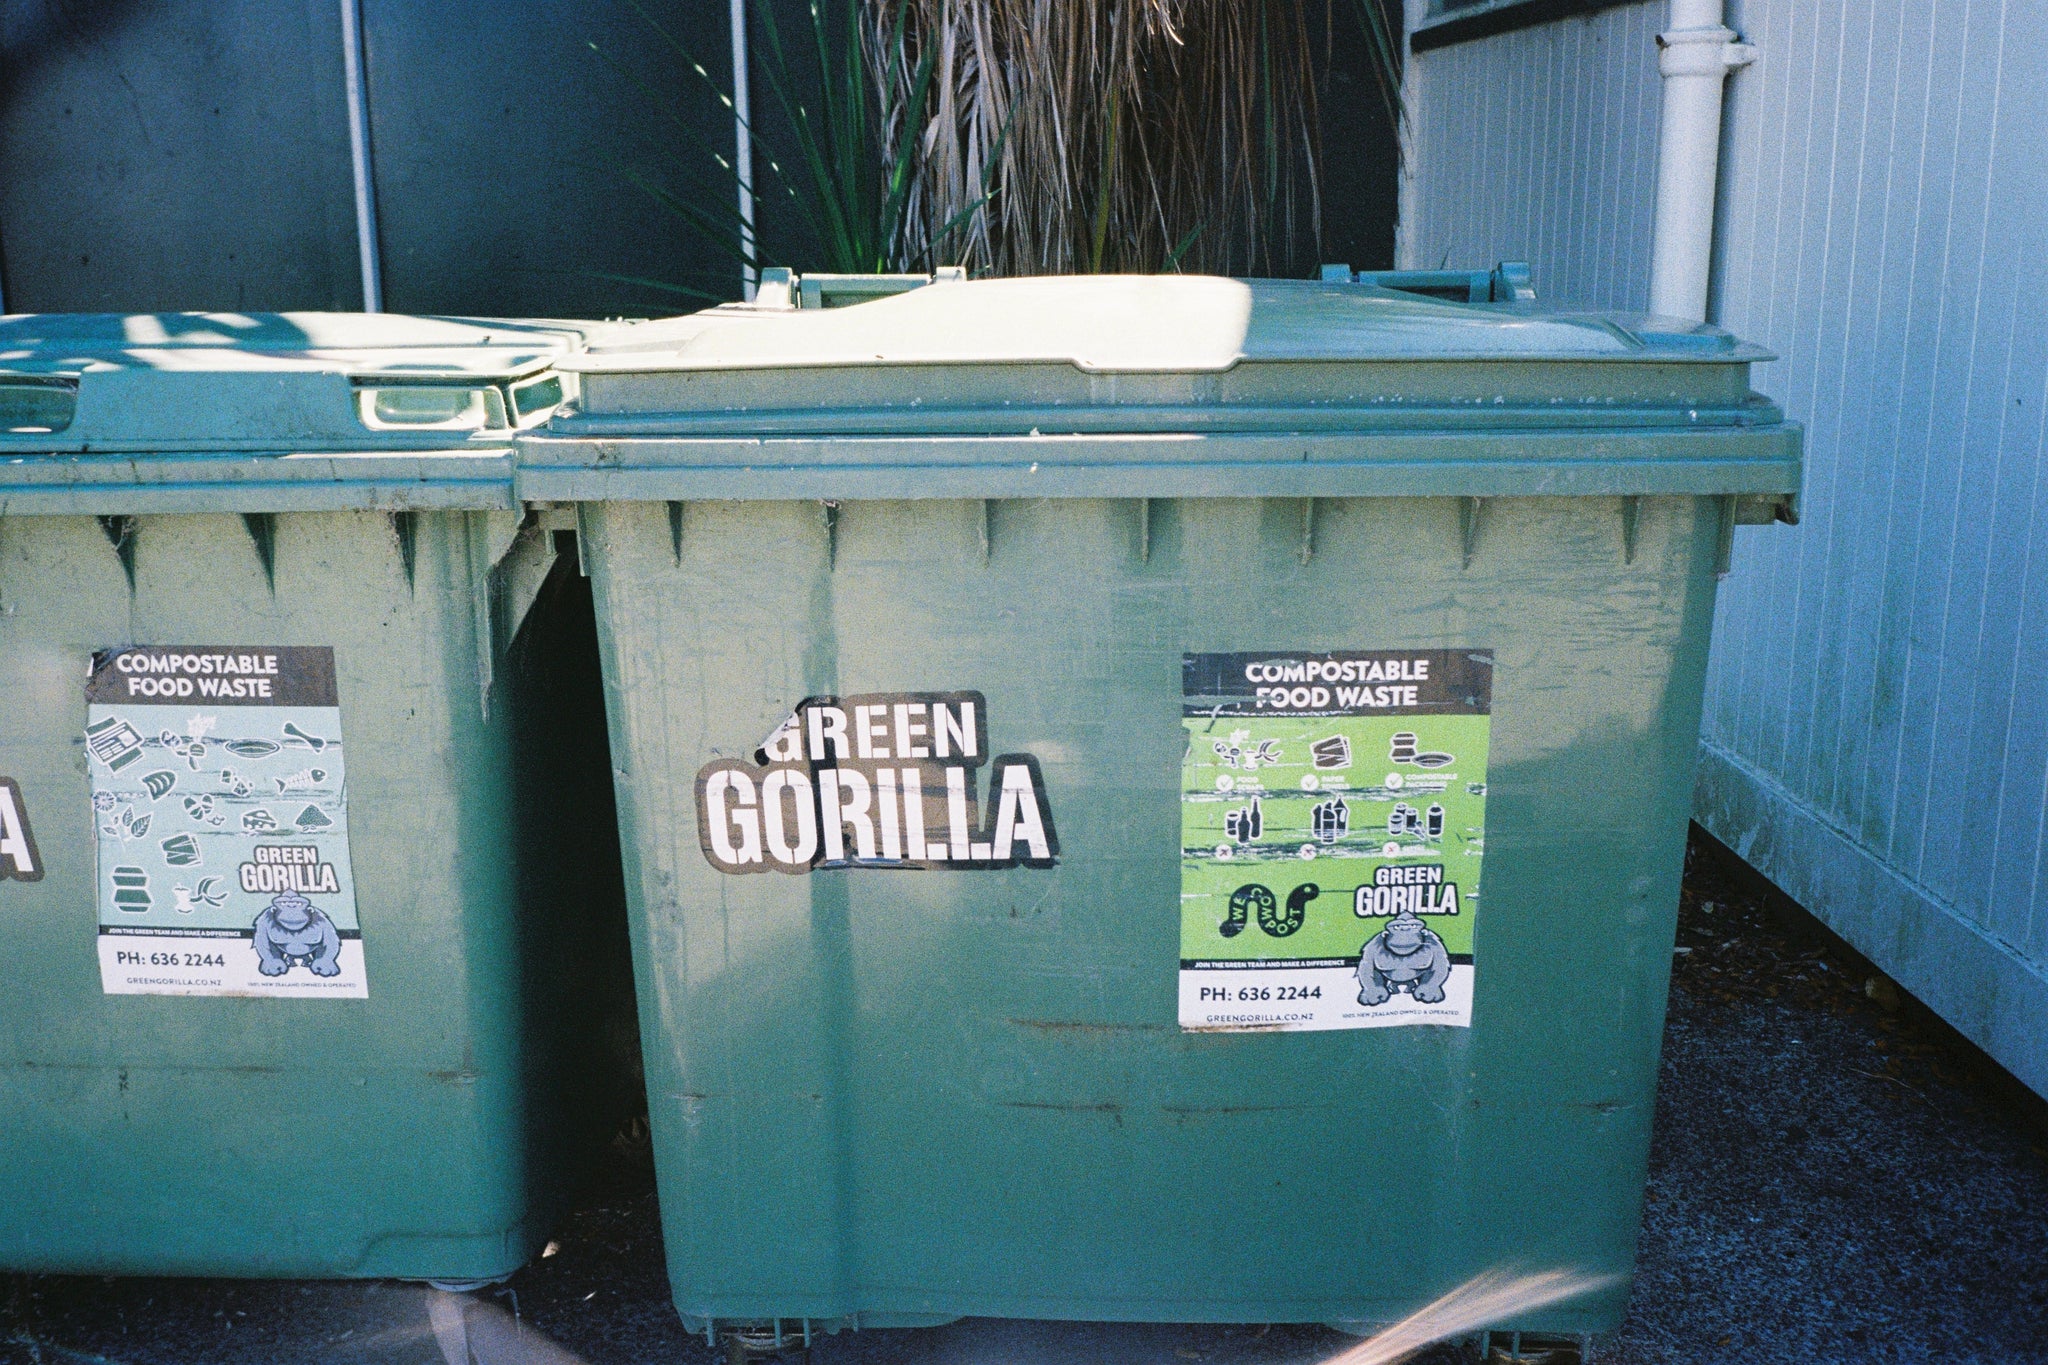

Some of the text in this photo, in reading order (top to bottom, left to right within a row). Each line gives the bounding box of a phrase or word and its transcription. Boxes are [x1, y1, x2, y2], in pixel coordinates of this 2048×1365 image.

[116, 653, 279, 674] COMPOSTABLE
[1245, 659, 1429, 682] COMPOSTABLE
[128, 677, 272, 697] FOOD WASTE
[1256, 685, 1418, 708] FOOD WASTE
[763, 702, 977, 762] GREEN
[706, 764, 1051, 865] GORILLA
[255, 846, 317, 864] GREEN
[240, 863, 338, 892] GORILLA
[1375, 866, 1441, 885] GREEN
[1356, 884, 1458, 916] GORILLA
[117, 951, 225, 967] PH: 636 2244
[126, 977, 222, 986] GREENGORILLA.CO.NZ
[1200, 985, 1322, 1001] PH: 636 2244
[1206, 1013, 1314, 1022] GREENGORILLA.CO.NZ
